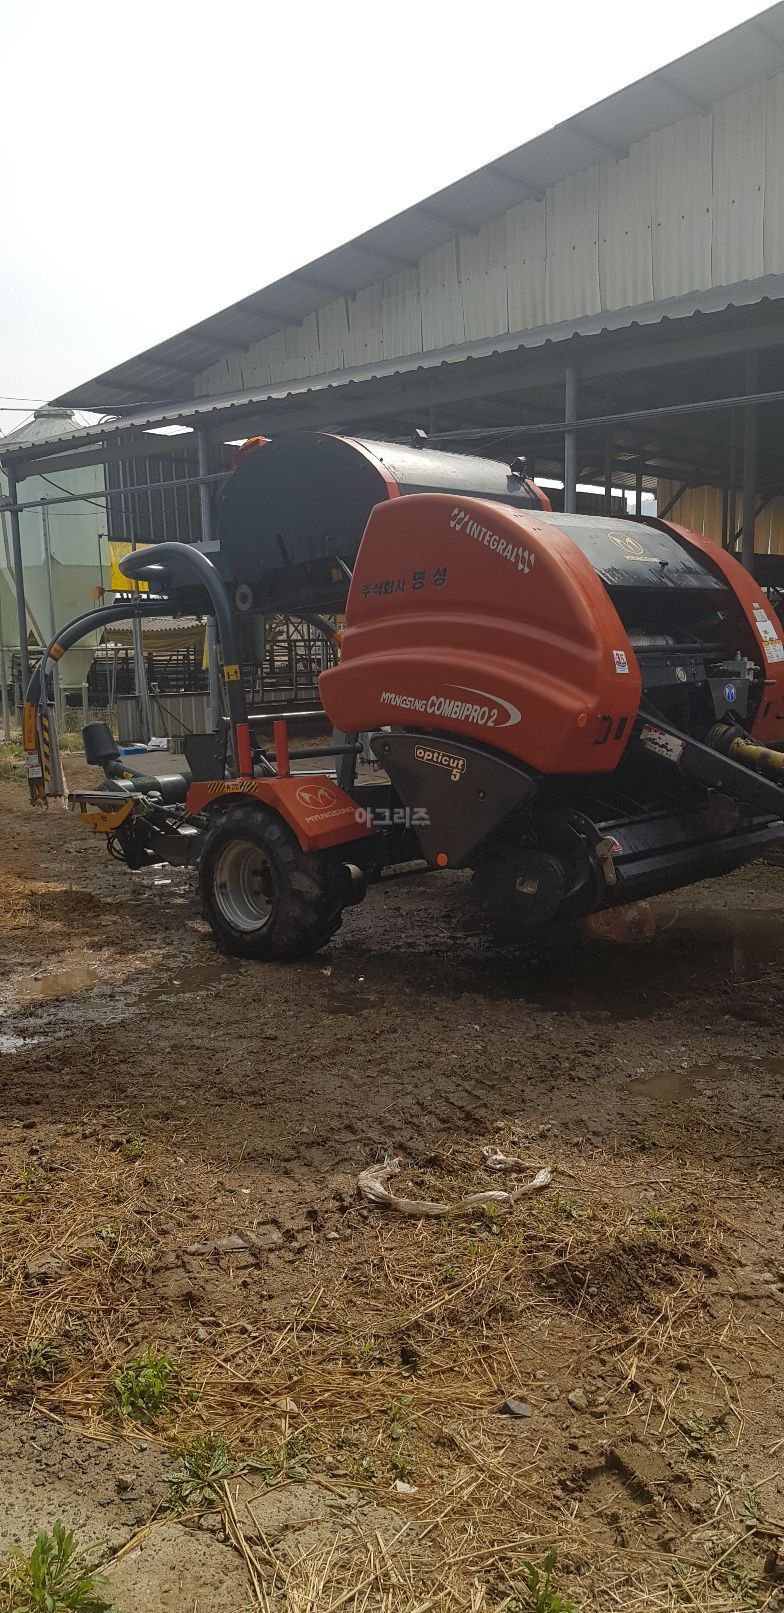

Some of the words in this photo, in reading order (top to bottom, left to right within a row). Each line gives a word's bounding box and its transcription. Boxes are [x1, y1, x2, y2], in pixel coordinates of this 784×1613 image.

[466, 519, 519, 563] INTEGRAL
[362, 578, 406, 598] 주식회사
[380, 691, 427, 712] MYUNGSUNG
[427, 695, 489, 725] COMBIPRO
[487, 708, 498, 727] 2
[416, 748, 465, 770] opticut
[450, 767, 462, 781] 5
[305, 806, 354, 824] MYUNGSUNG
